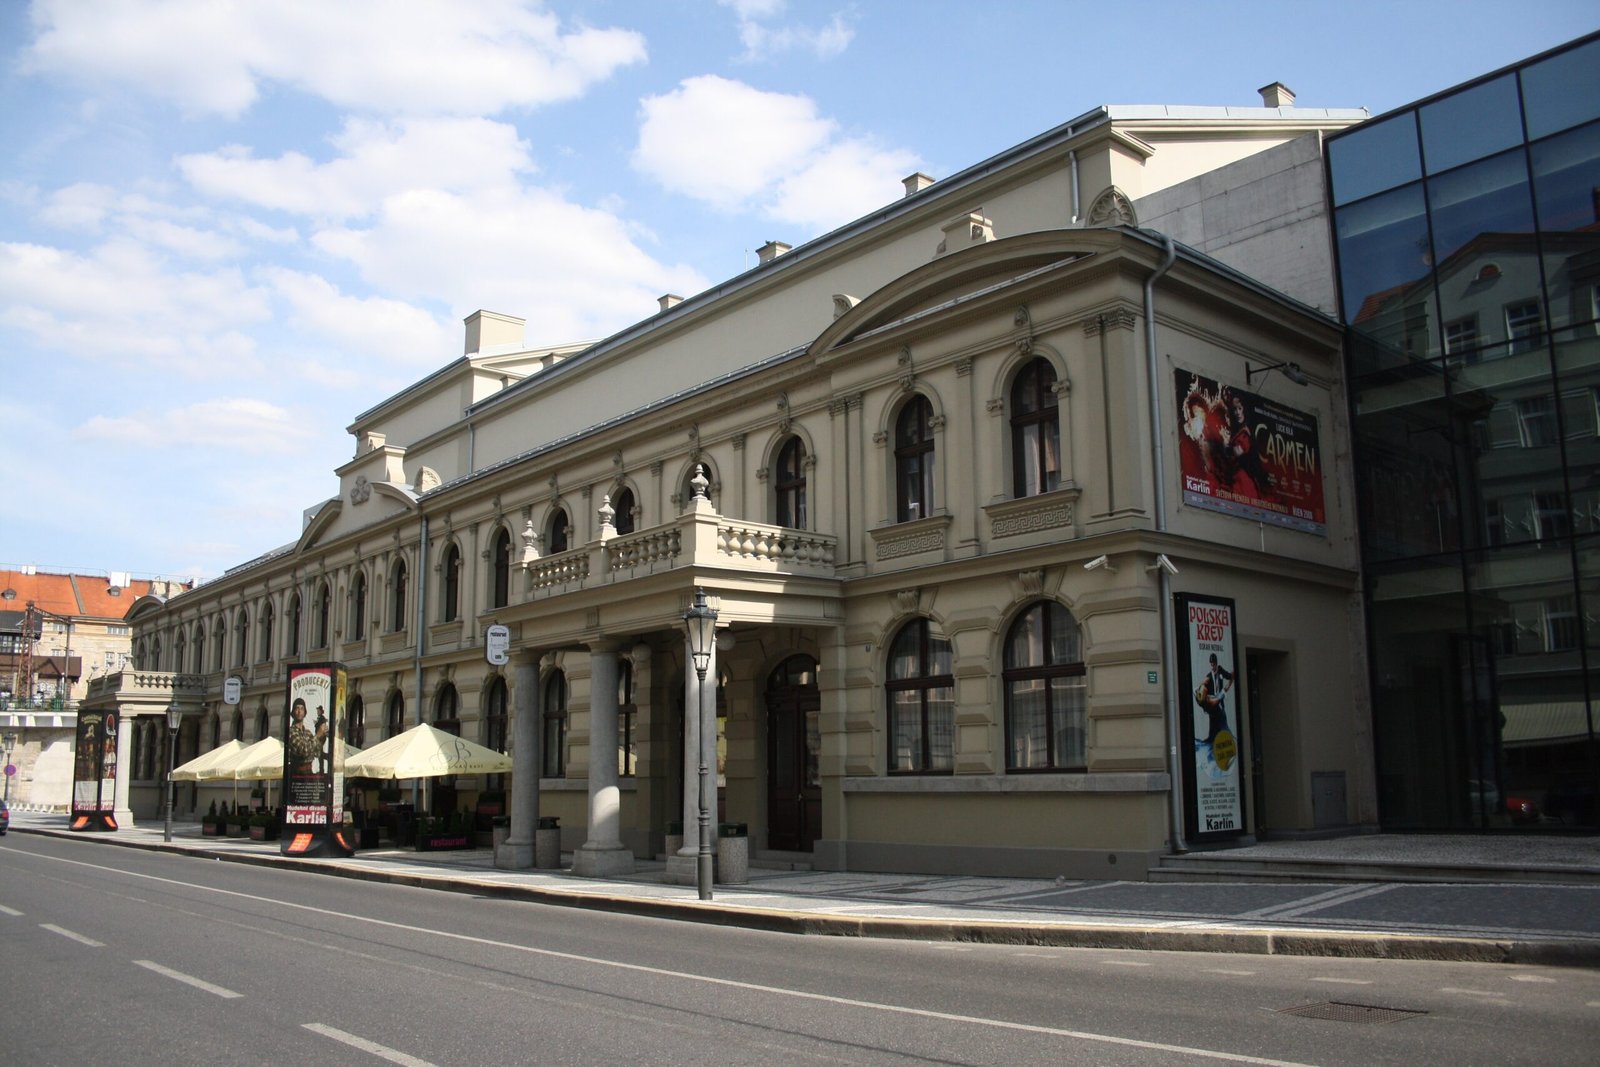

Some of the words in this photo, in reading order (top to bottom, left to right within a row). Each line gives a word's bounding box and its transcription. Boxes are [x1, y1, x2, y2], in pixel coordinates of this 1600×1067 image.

[1254, 423, 1315, 480] CARMEN
[1189, 605, 1230, 626] POLSKÁ
[1196, 623, 1225, 642] KREV
[286, 811, 327, 824] Karlín
[1206, 817, 1234, 831] Karlín
